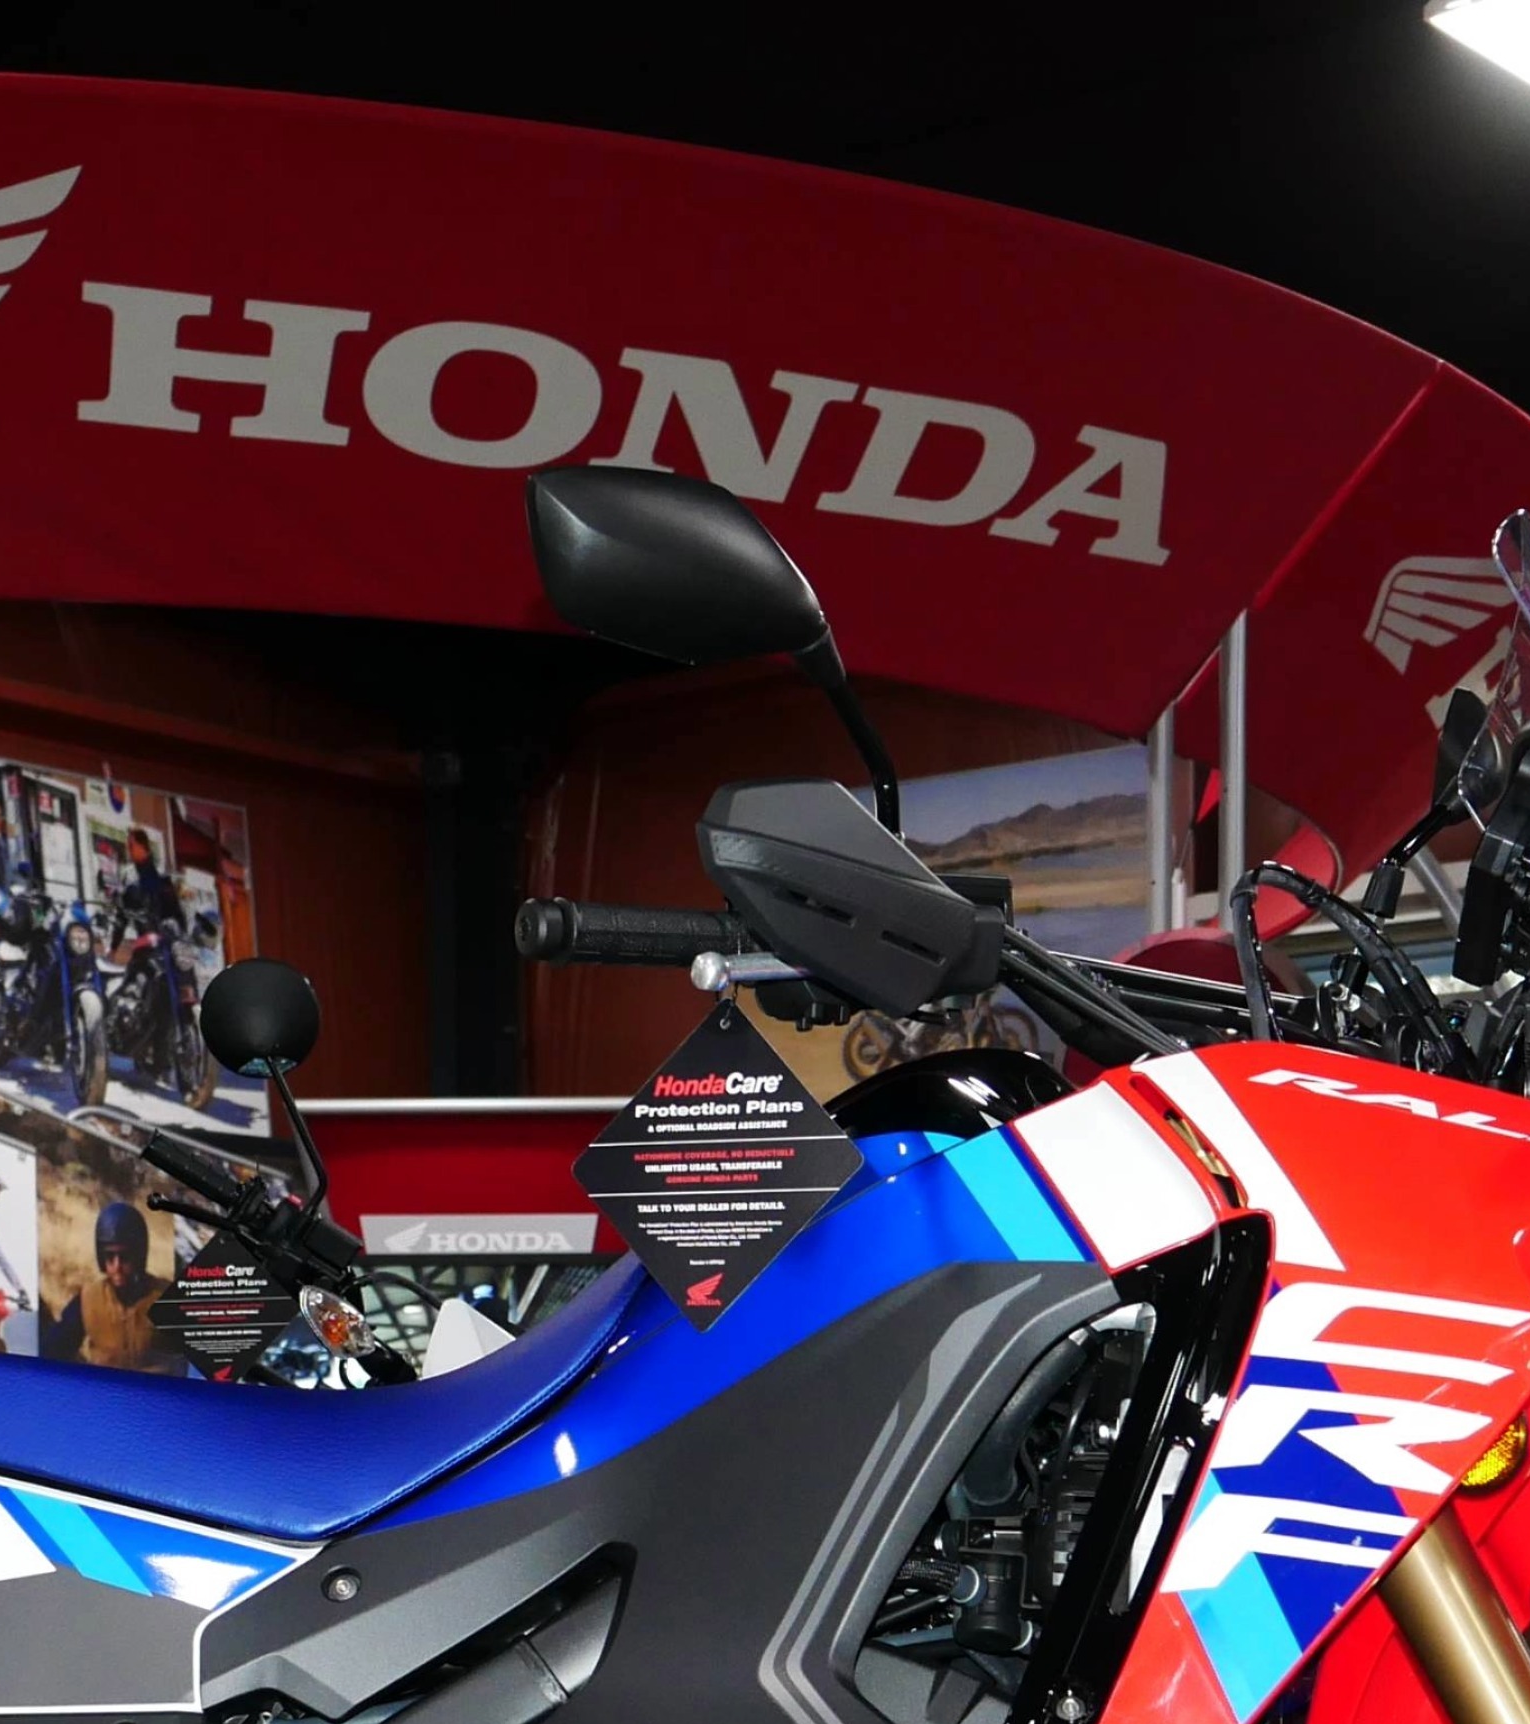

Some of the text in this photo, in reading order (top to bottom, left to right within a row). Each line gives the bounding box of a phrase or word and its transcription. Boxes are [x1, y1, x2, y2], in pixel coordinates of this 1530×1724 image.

[78, 281, 1173, 566] HONDA
[634, 1100, 804, 1119] Protection Plans
[656, 1123, 695, 1132] OPTIONAL
[697, 1121, 736, 1131] ROADSIDE
[738, 1120, 788, 1130] ASSISTANCE
[644, 1164, 688, 1173] UNLIMITED
[720, 1161, 782, 1171] TRANSFERABLE
[637, 1204, 658, 1213] TALK
[660, 1203, 672, 1212] TO
[673, 1203, 696, 1212] YOUR
[697, 1202, 730, 1211] DEALER
[731, 1202, 747, 1211] FOR
[428, 1232, 574, 1251] HONDA
[177, 1278, 268, 1289] Protection Plans
